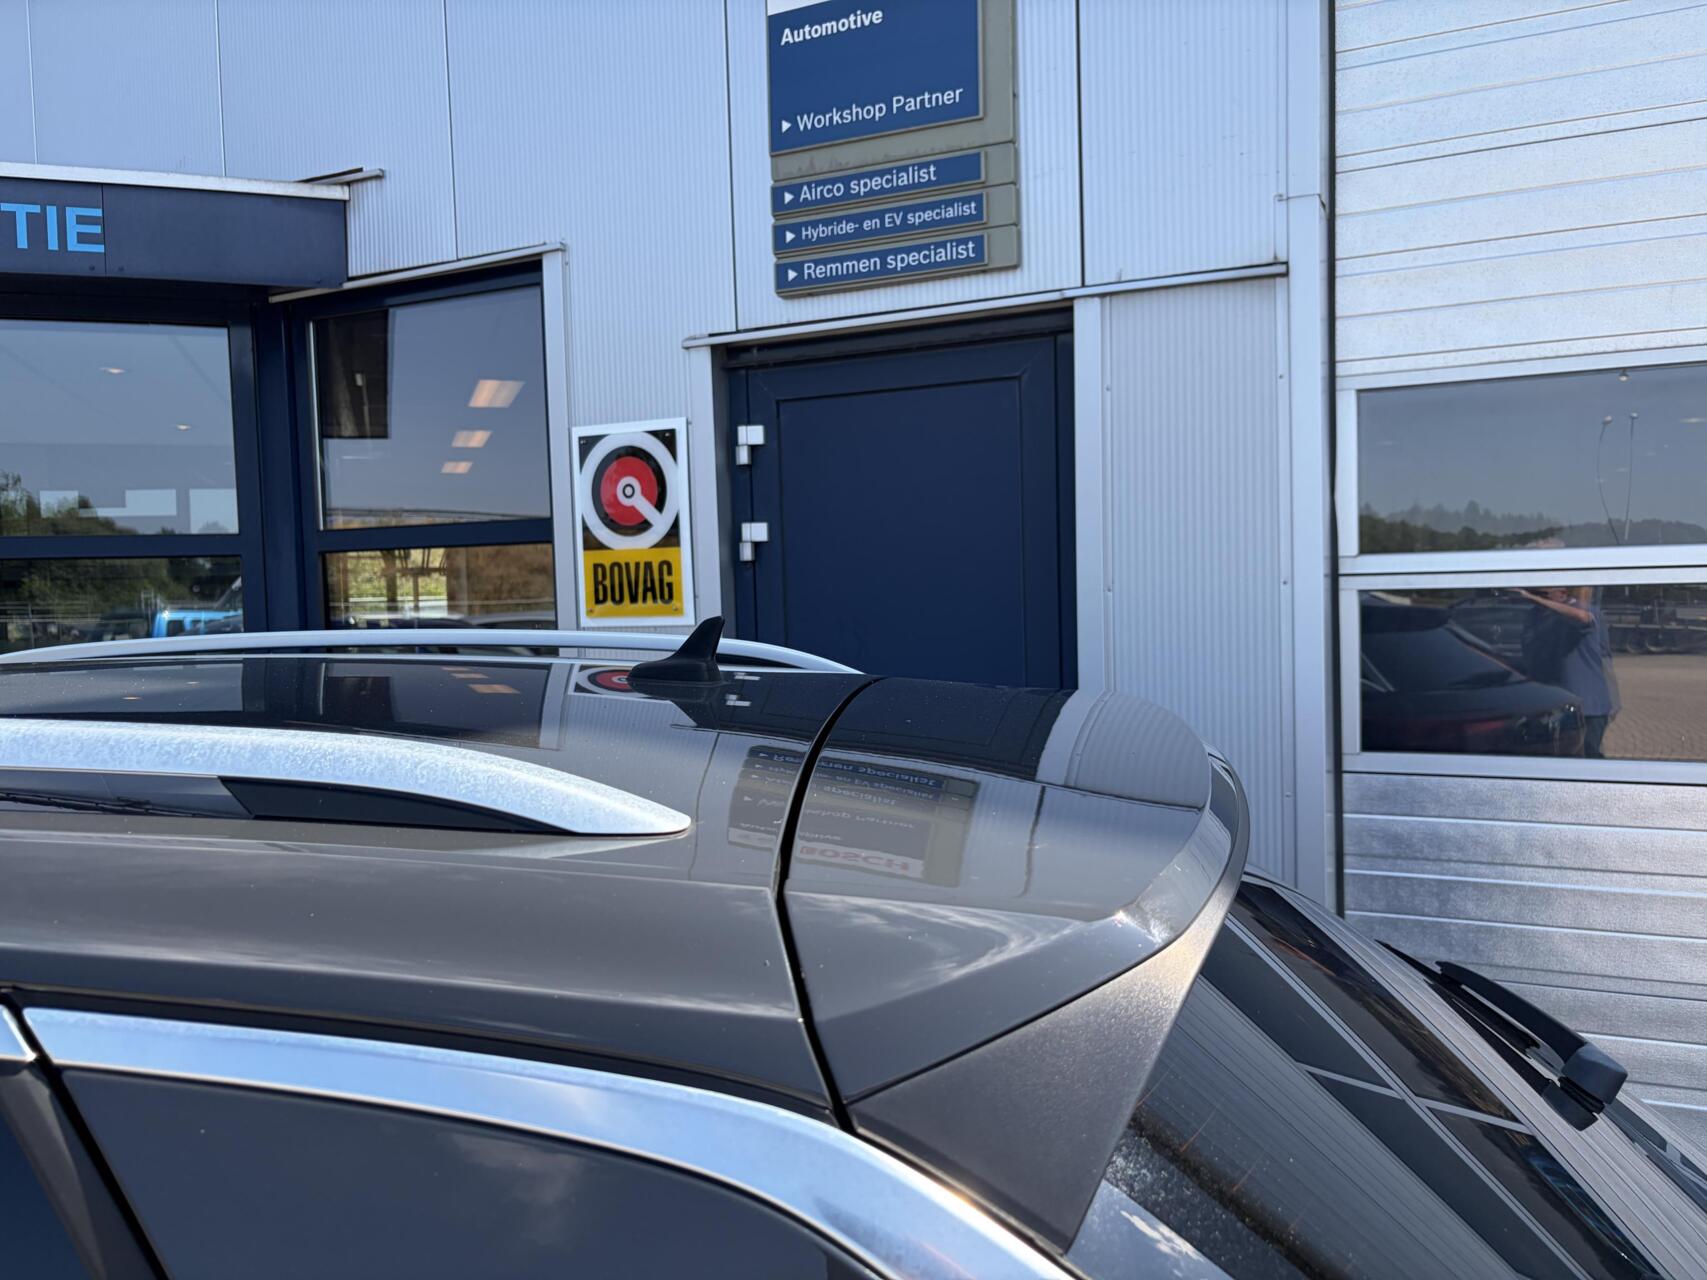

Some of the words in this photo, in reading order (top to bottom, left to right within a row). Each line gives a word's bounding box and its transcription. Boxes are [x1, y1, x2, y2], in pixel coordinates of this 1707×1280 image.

[780, 9, 883, 46] Automotive
[796, 103, 887, 132] Workshop
[892, 88, 963, 115] Partner
[799, 183, 845, 203] Airco
[850, 164, 936, 195] specialist
[0, 203, 105, 253] TIE
[801, 223, 860, 241] Hybride-
[863, 216, 881, 231] en
[884, 211, 904, 229] EV
[906, 202, 977, 225] specialist
[803, 255, 881, 280] Remmen
[886, 240, 976, 271] specialist
[592, 560, 674, 606] BOVAG
